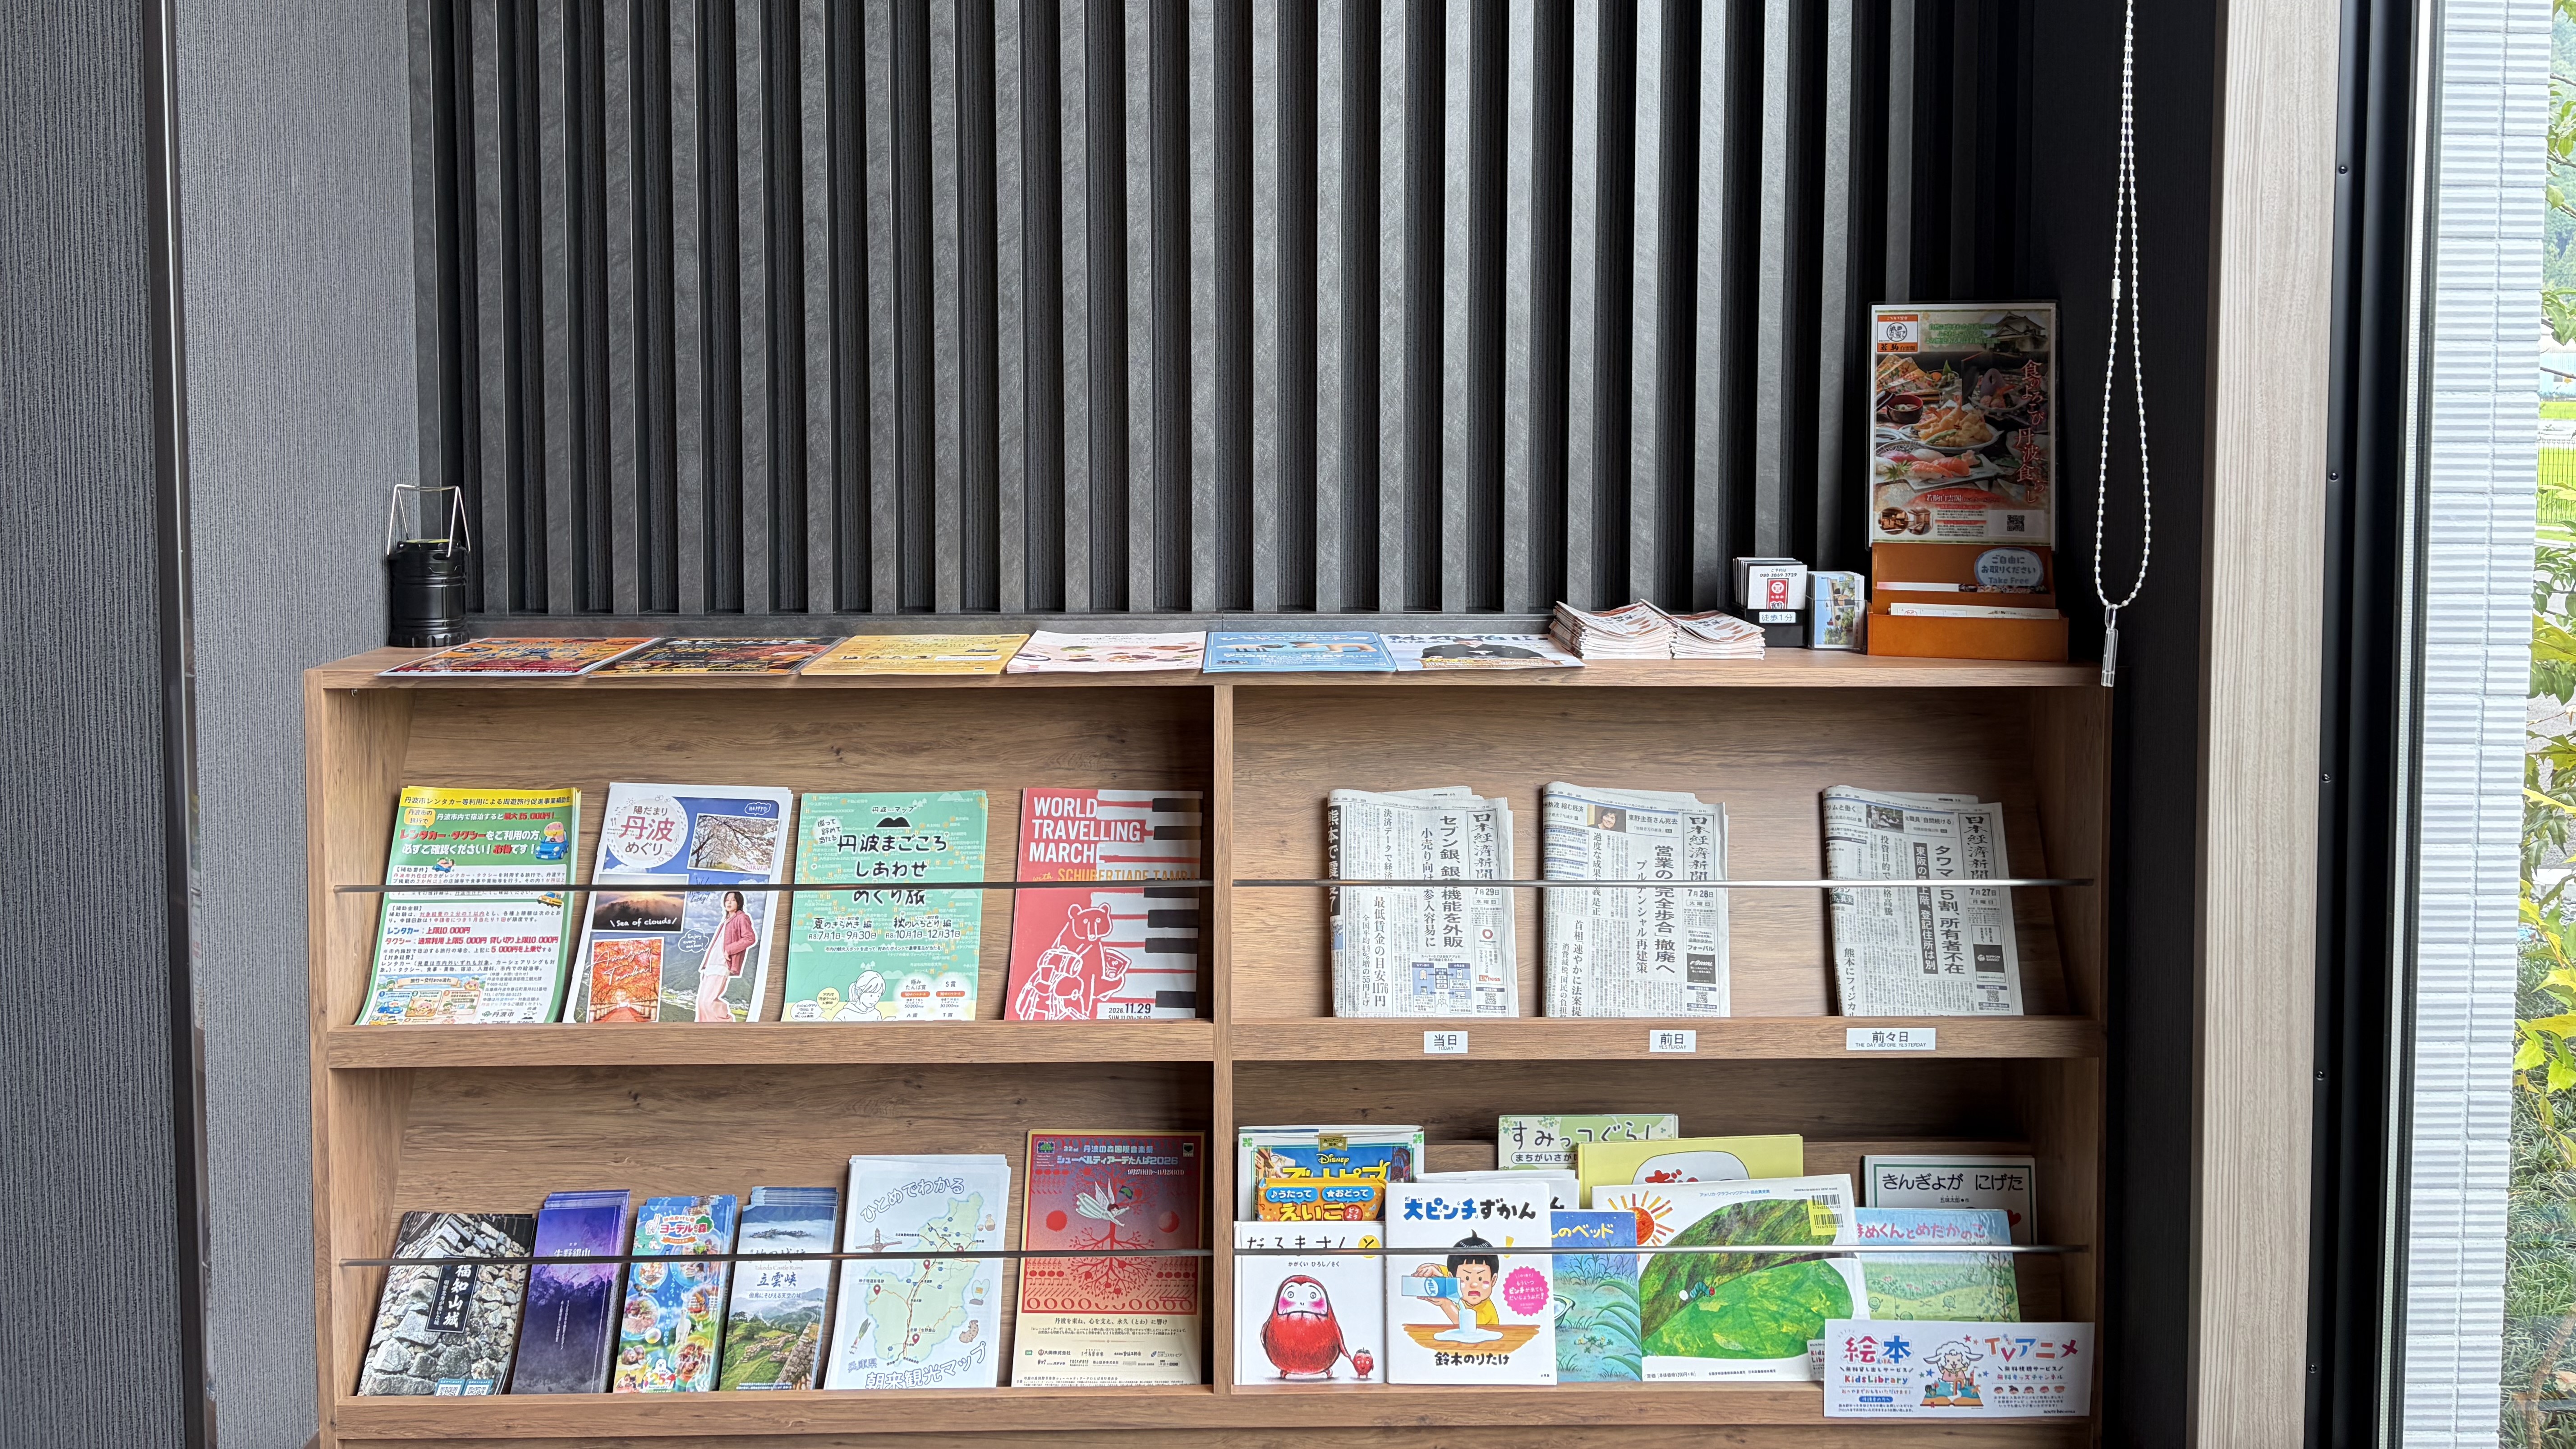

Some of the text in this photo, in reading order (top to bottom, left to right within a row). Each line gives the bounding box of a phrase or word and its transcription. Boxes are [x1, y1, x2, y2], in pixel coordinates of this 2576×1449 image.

[1992, 555, 2025, 564] ご自由に
[1981, 566, 2036, 574] お取りください
[633, 805, 667, 816] 陽だまり
[1034, 797, 1097, 818] WORLD
[618, 815, 675, 842] 丹波
[817, 819, 836, 827] 巡って
[1032, 819, 1141, 841] TRAVELLING
[625, 842, 662, 856] めぐり
[837, 833, 947, 852] 丹波まごころ
[1029, 842, 1105, 864] MARCHE
[856, 861, 927, 878] しあわせ
[1032, 872, 1053, 881] with
[1474, 887, 1500, 897] 7月29日
[1687, 889, 1713, 897] 7月28日
[644, 917, 671, 925] clouds
[1434, 1034, 1457, 1045] 当日
[1661, 1033, 1684, 1045] 前日
[1872, 1031, 1908, 1043] 前々日
[1882, 1174, 2023, 1191] きんぎょが にげた
[860, 1177, 965, 1223] ひとめでわかる
[1334, 1189, 1368, 1197] おどって
[1280, 1203, 1345, 1221] えいご
[1403, 1197, 1536, 1220] 大ピンチずかん
[757, 1271, 797, 1288] 立雲峡
[1426, 1279, 1436, 1295] MILK
[443, 1265, 472, 1328] 福知山城
[1844, 1335, 1912, 1364] 絵本
[1985, 1337, 2078, 1362] TVアニメ
[1434, 1352, 1509, 1366] 鈴木のりたけ
[1845, 1375, 1908, 1385] KidsLibrary
